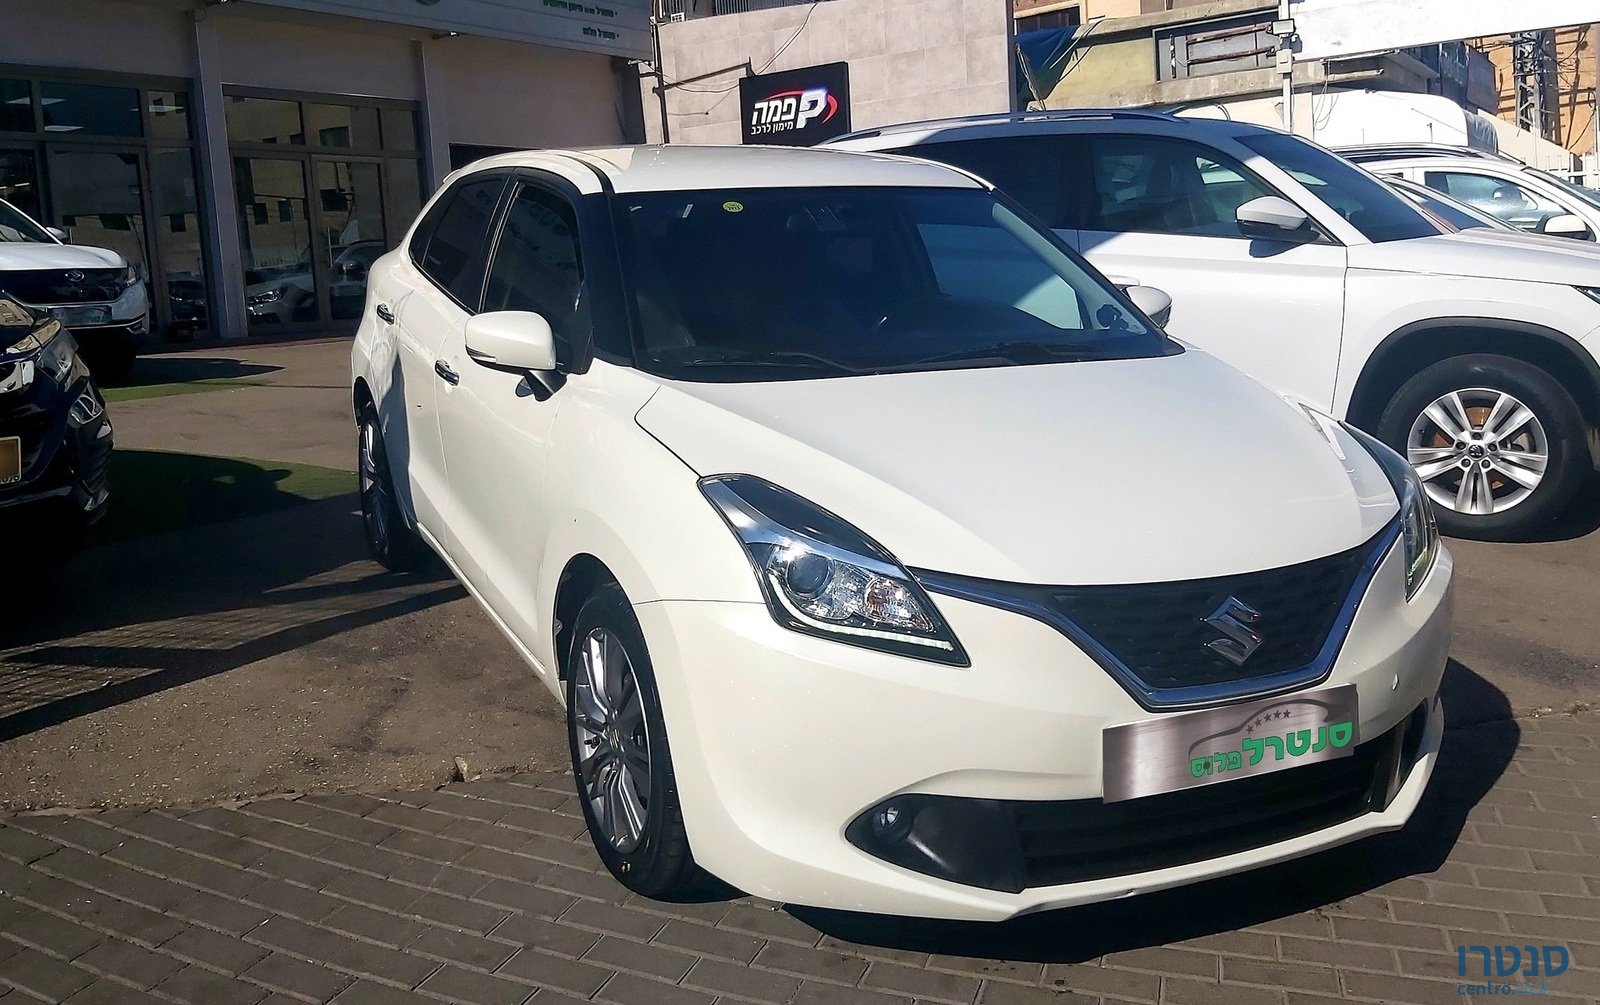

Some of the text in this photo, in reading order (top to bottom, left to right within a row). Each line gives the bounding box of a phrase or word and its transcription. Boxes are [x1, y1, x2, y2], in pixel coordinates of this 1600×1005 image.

[751, 97, 797, 126] פמה
[750, 121, 794, 135] מימון לרכב
[1189, 721, 1353, 778] סנטרל פלוס
